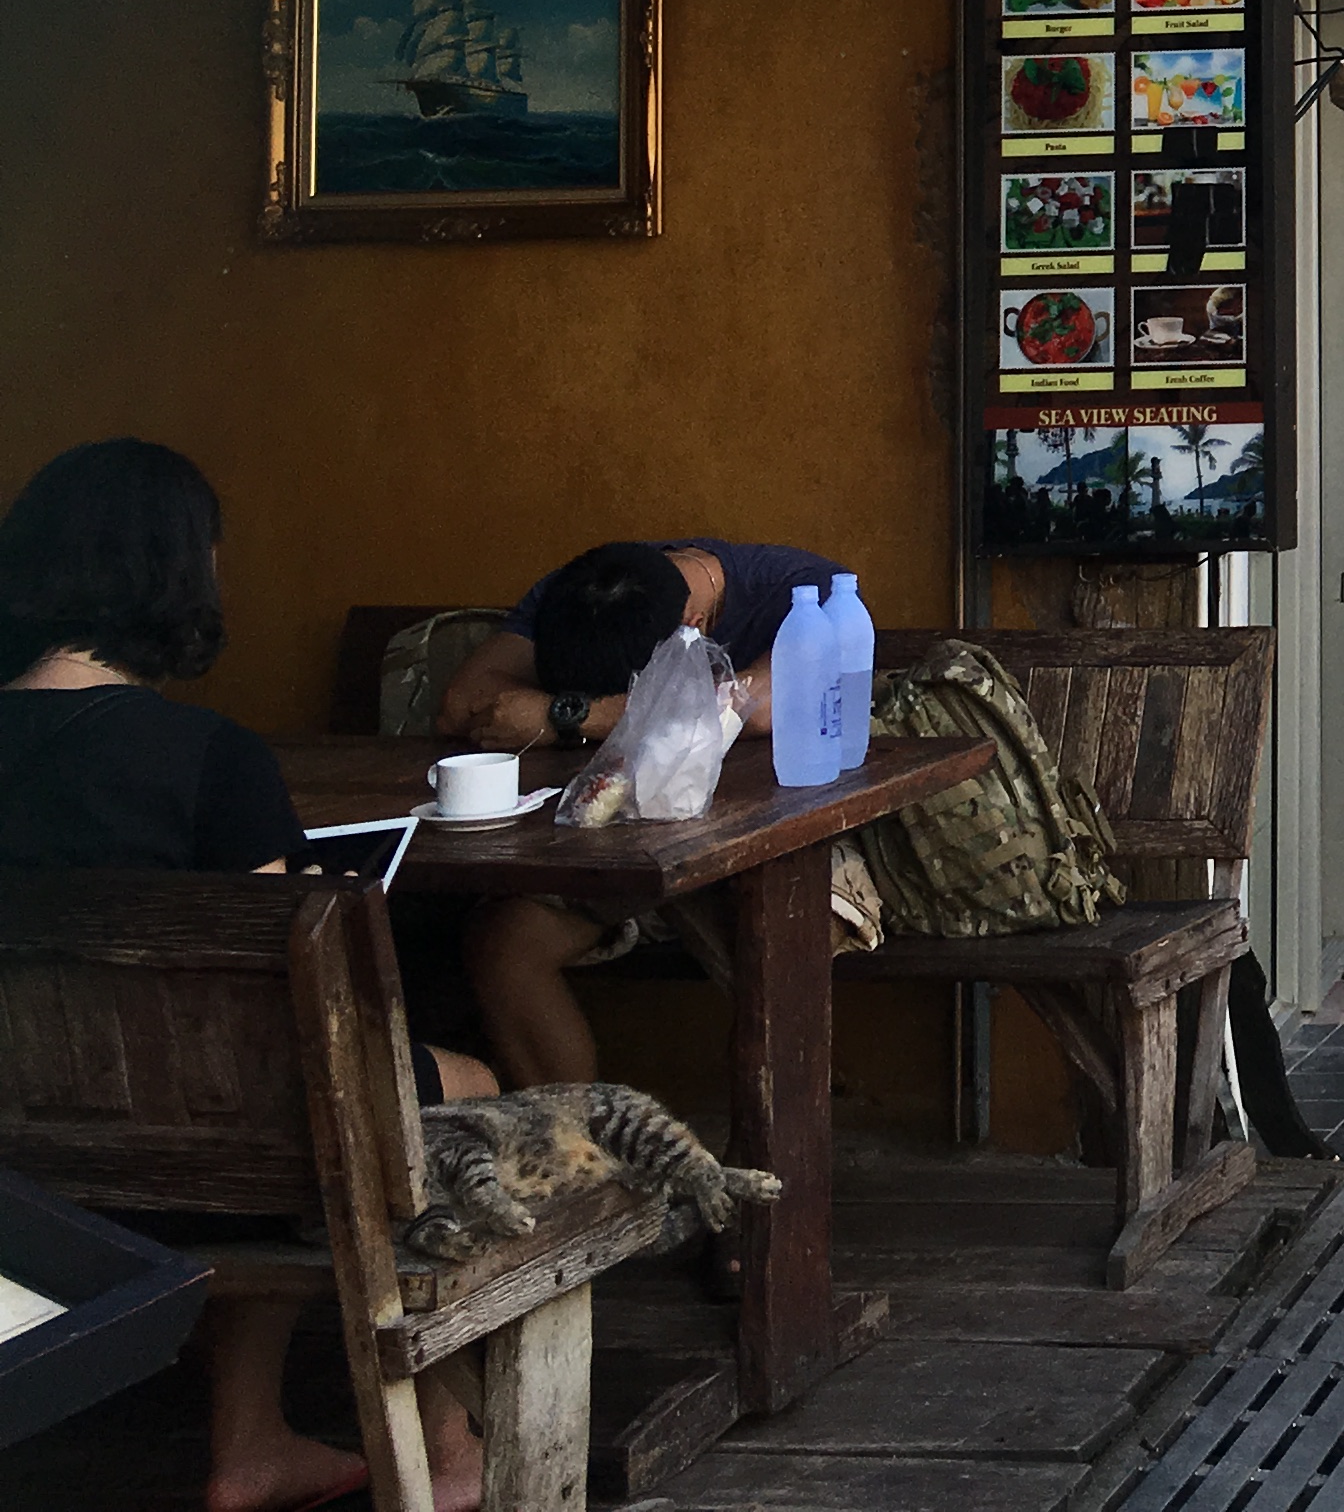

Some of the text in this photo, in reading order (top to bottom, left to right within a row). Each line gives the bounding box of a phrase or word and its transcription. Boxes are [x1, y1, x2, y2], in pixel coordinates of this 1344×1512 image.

[1189, 374, 1215, 383] Coffee
[1039, 406, 1218, 426] SEA VIEW SEATING
